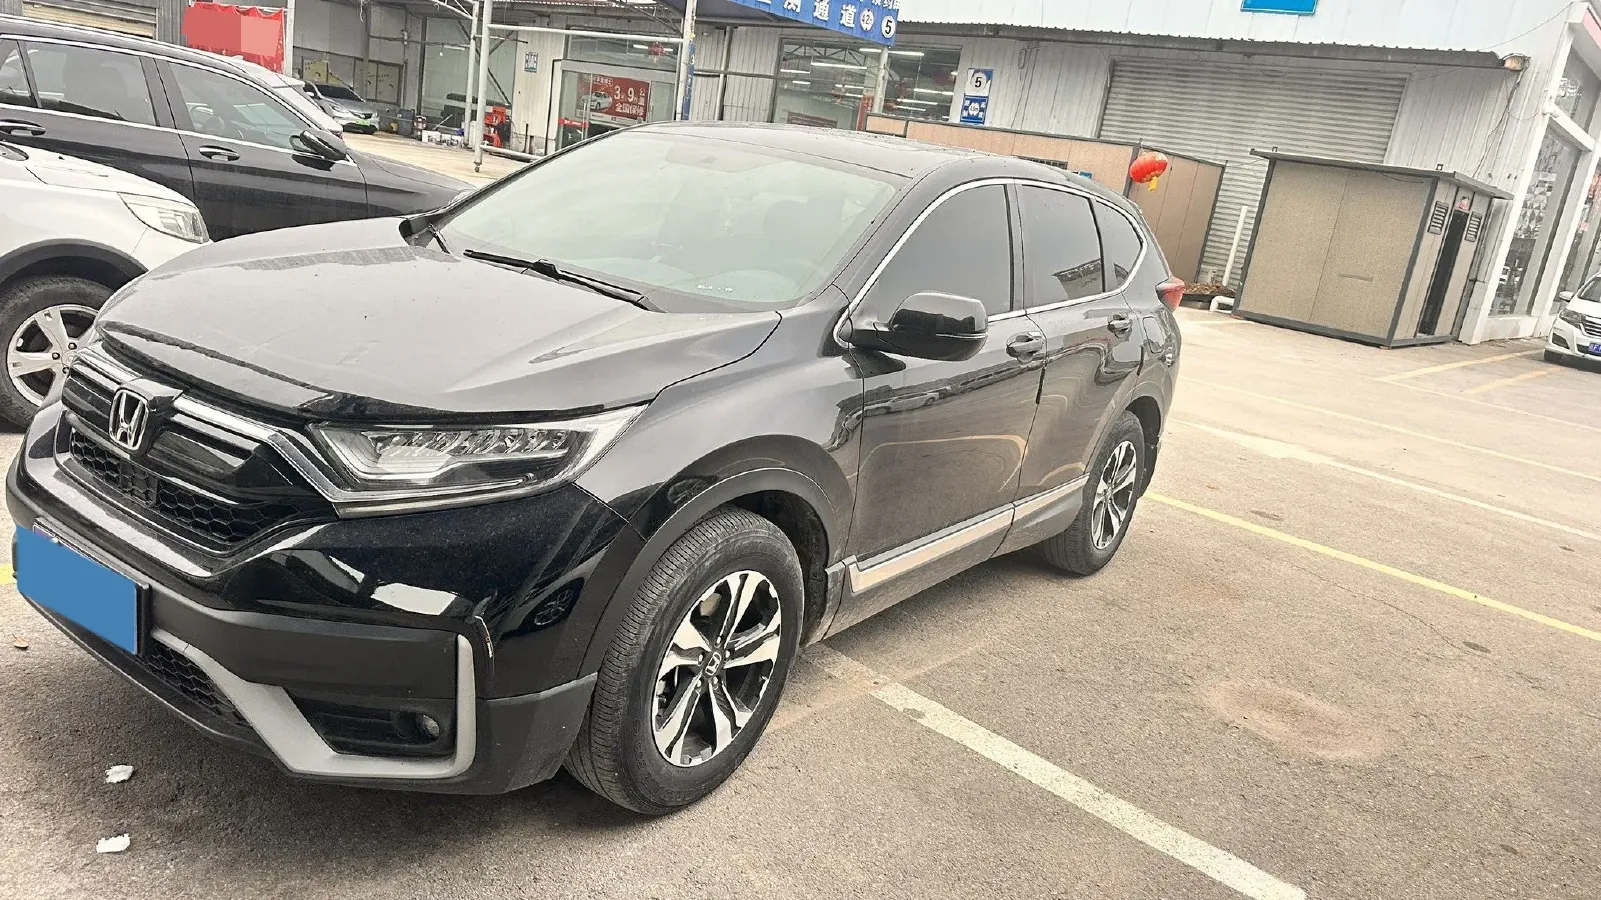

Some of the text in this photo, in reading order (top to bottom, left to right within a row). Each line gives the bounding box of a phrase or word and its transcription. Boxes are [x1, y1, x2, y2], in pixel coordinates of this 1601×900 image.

[884, 19, 892, 35] 5
[974, 76, 983, 88] 5
[615, 103, 644, 116] 全国保修
